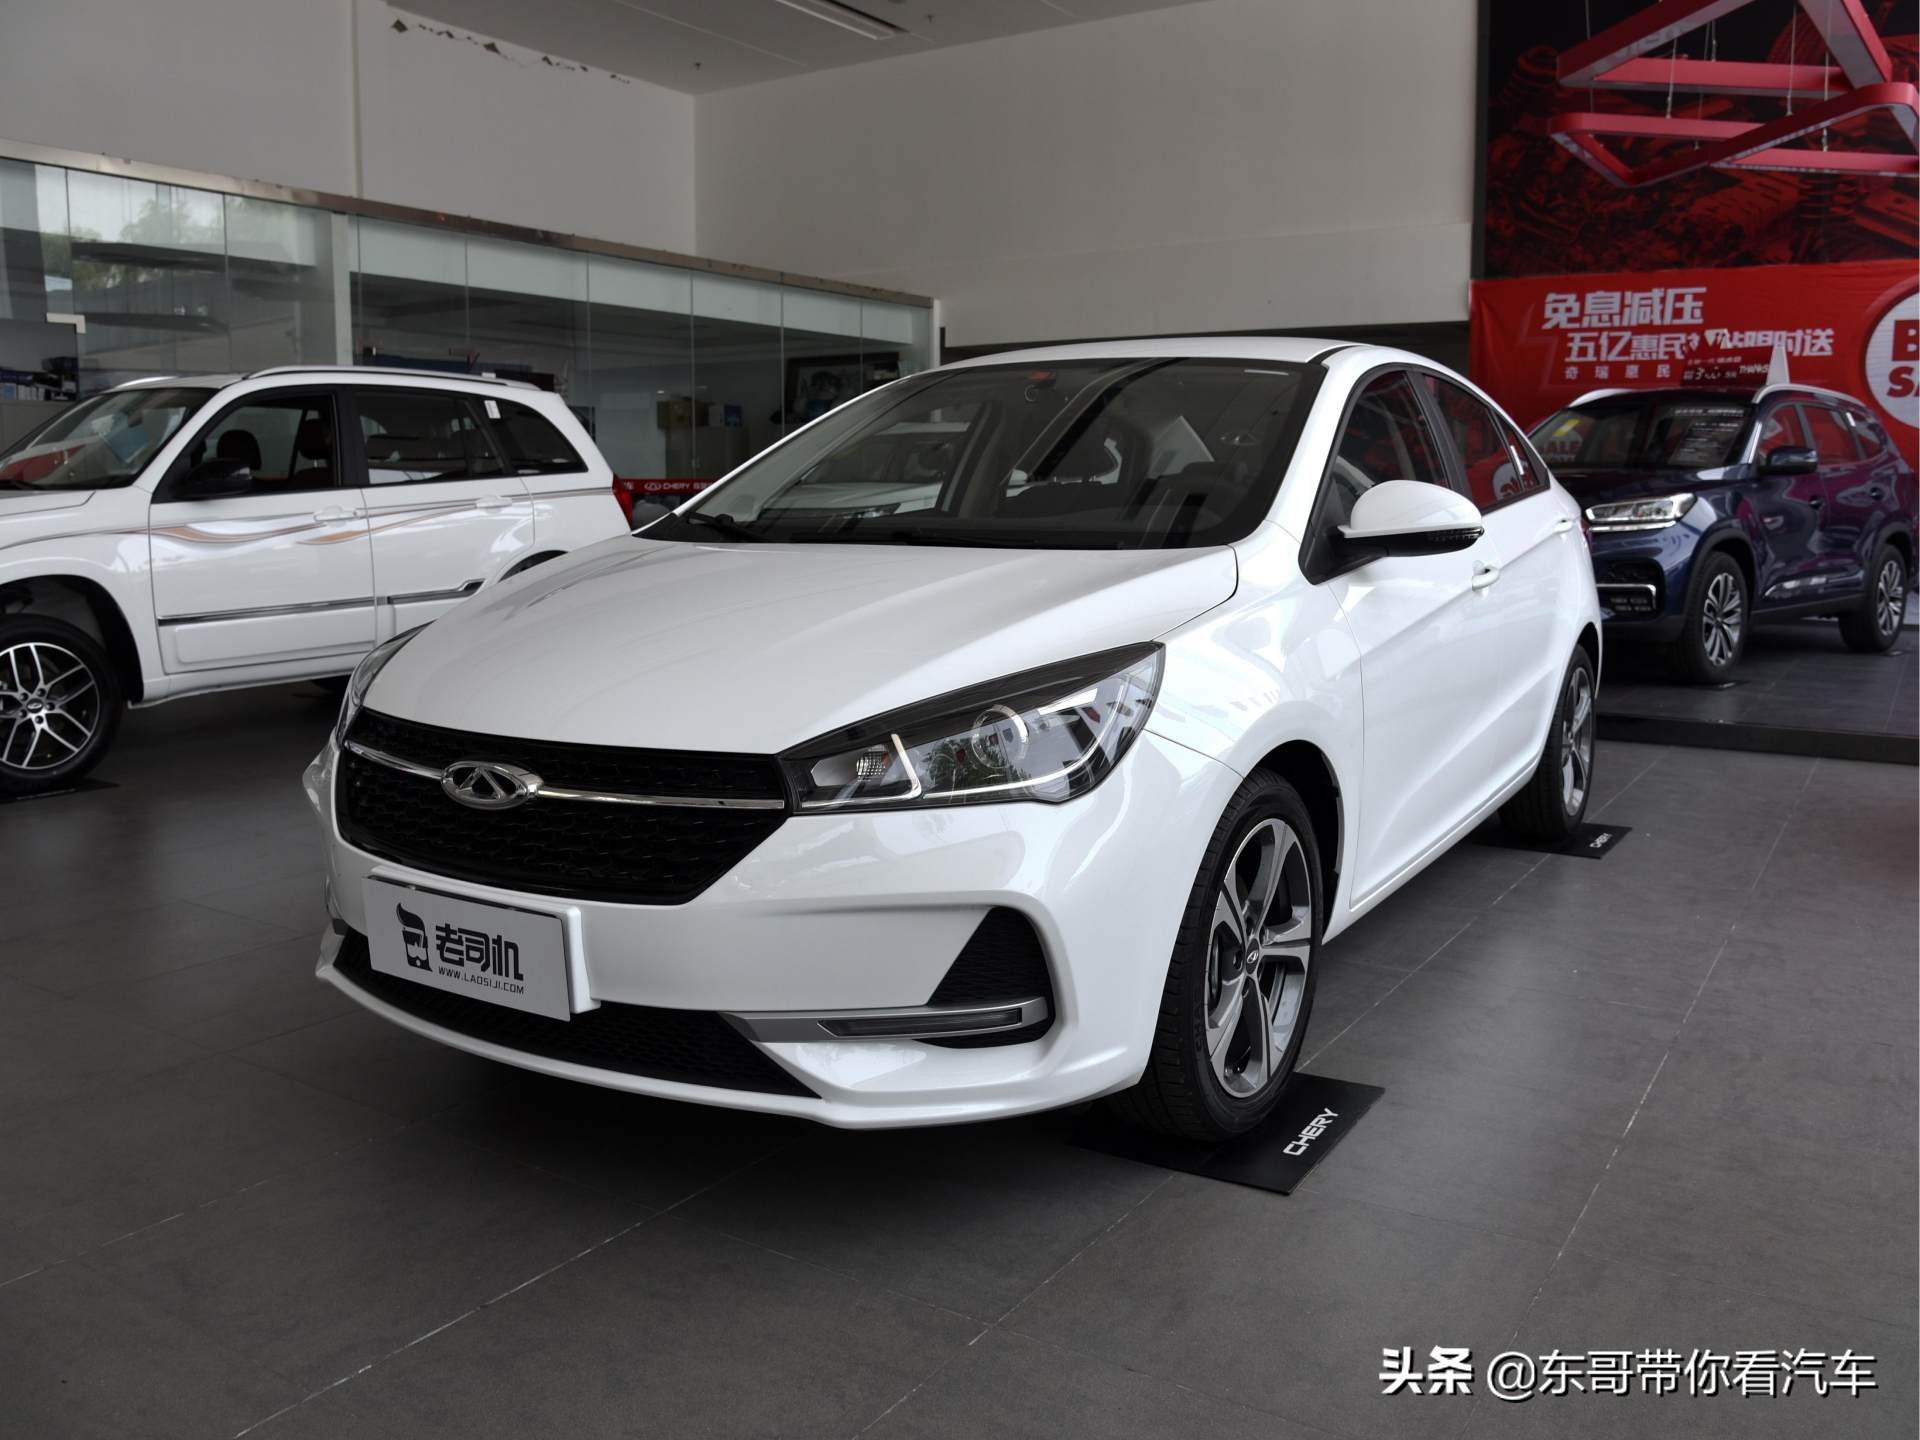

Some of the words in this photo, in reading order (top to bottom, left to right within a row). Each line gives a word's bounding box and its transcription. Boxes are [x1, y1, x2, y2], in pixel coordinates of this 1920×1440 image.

[1542, 287, 1706, 329] 免息减压
[435, 923, 524, 981] 老司机
[438, 965, 525, 995] WWW.LAOSIJI.COM
[1282, 1107, 1339, 1156] CHERY
